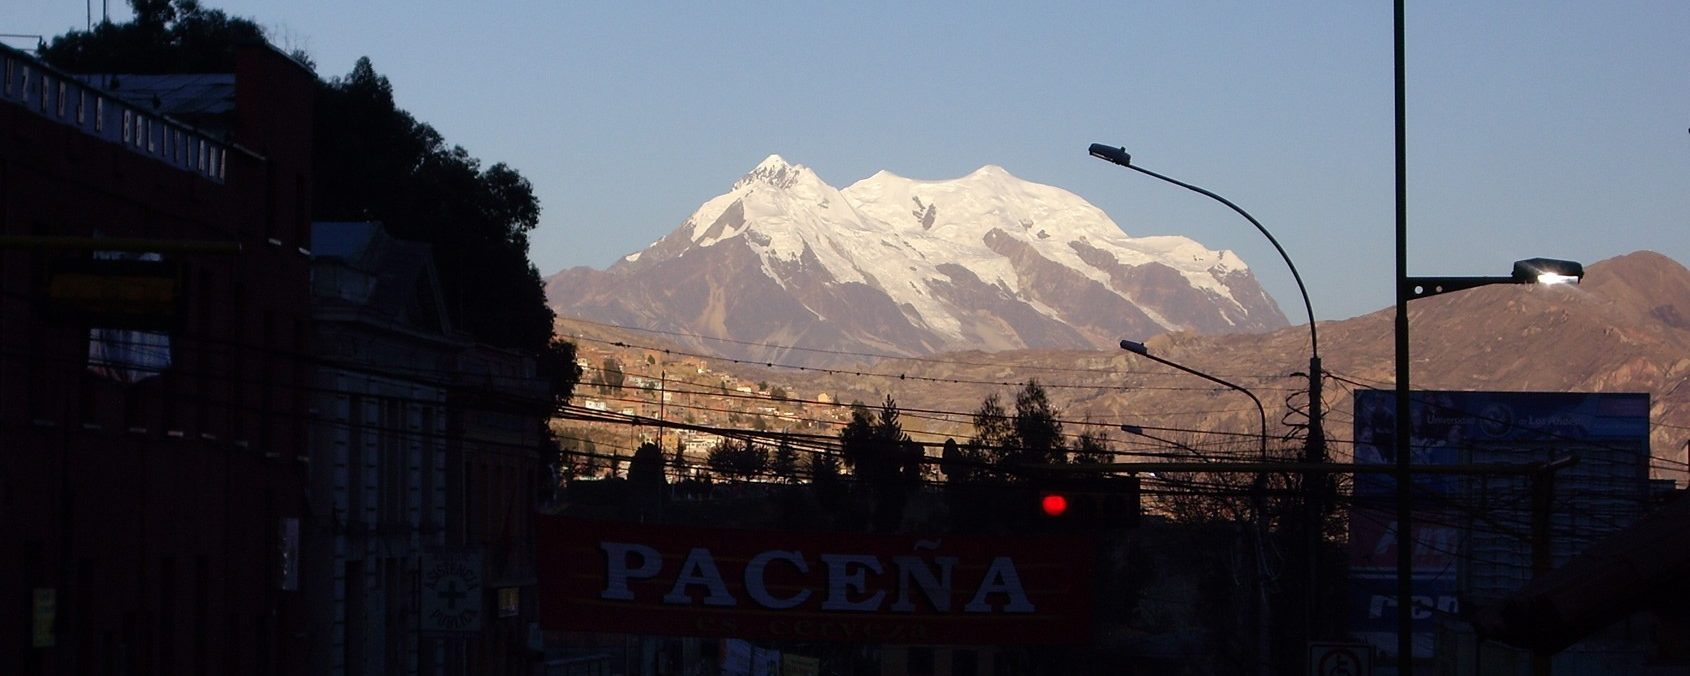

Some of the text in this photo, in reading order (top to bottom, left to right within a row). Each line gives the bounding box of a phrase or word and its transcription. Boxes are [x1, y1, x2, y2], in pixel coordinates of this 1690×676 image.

[42, 75, 103, 132] ROJA
[122, 109, 227, 180] BOLIVIANA
[599, 537, 1037, 615] PACEÑA
[768, 618, 928, 640] cerveza
